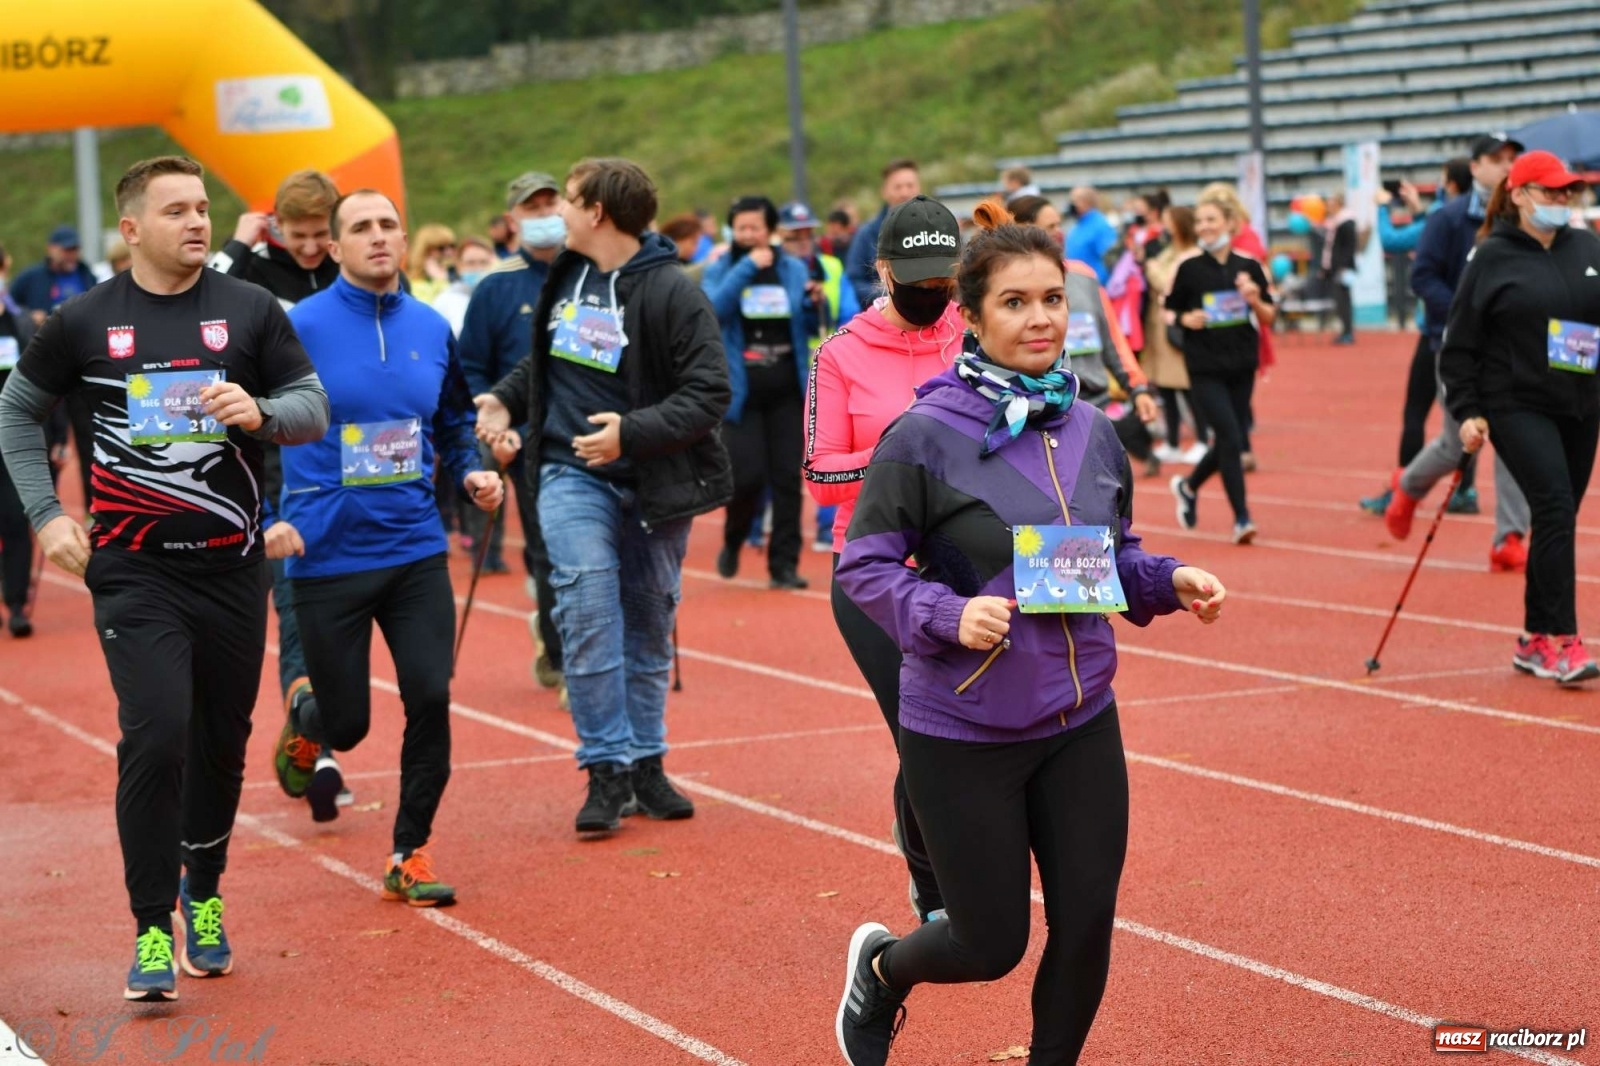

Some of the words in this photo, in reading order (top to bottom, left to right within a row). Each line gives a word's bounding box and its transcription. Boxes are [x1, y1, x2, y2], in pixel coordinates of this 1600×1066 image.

[902, 230, 957, 249] adidas
[140, 399, 160, 408] BIEG
[164, 398, 181, 407] DLA
[188, 419, 218, 433] 219
[1028, 557, 1050, 568] BIEG
[1053, 557, 1072, 568] DLA
[1078, 586, 1114, 601] 045
